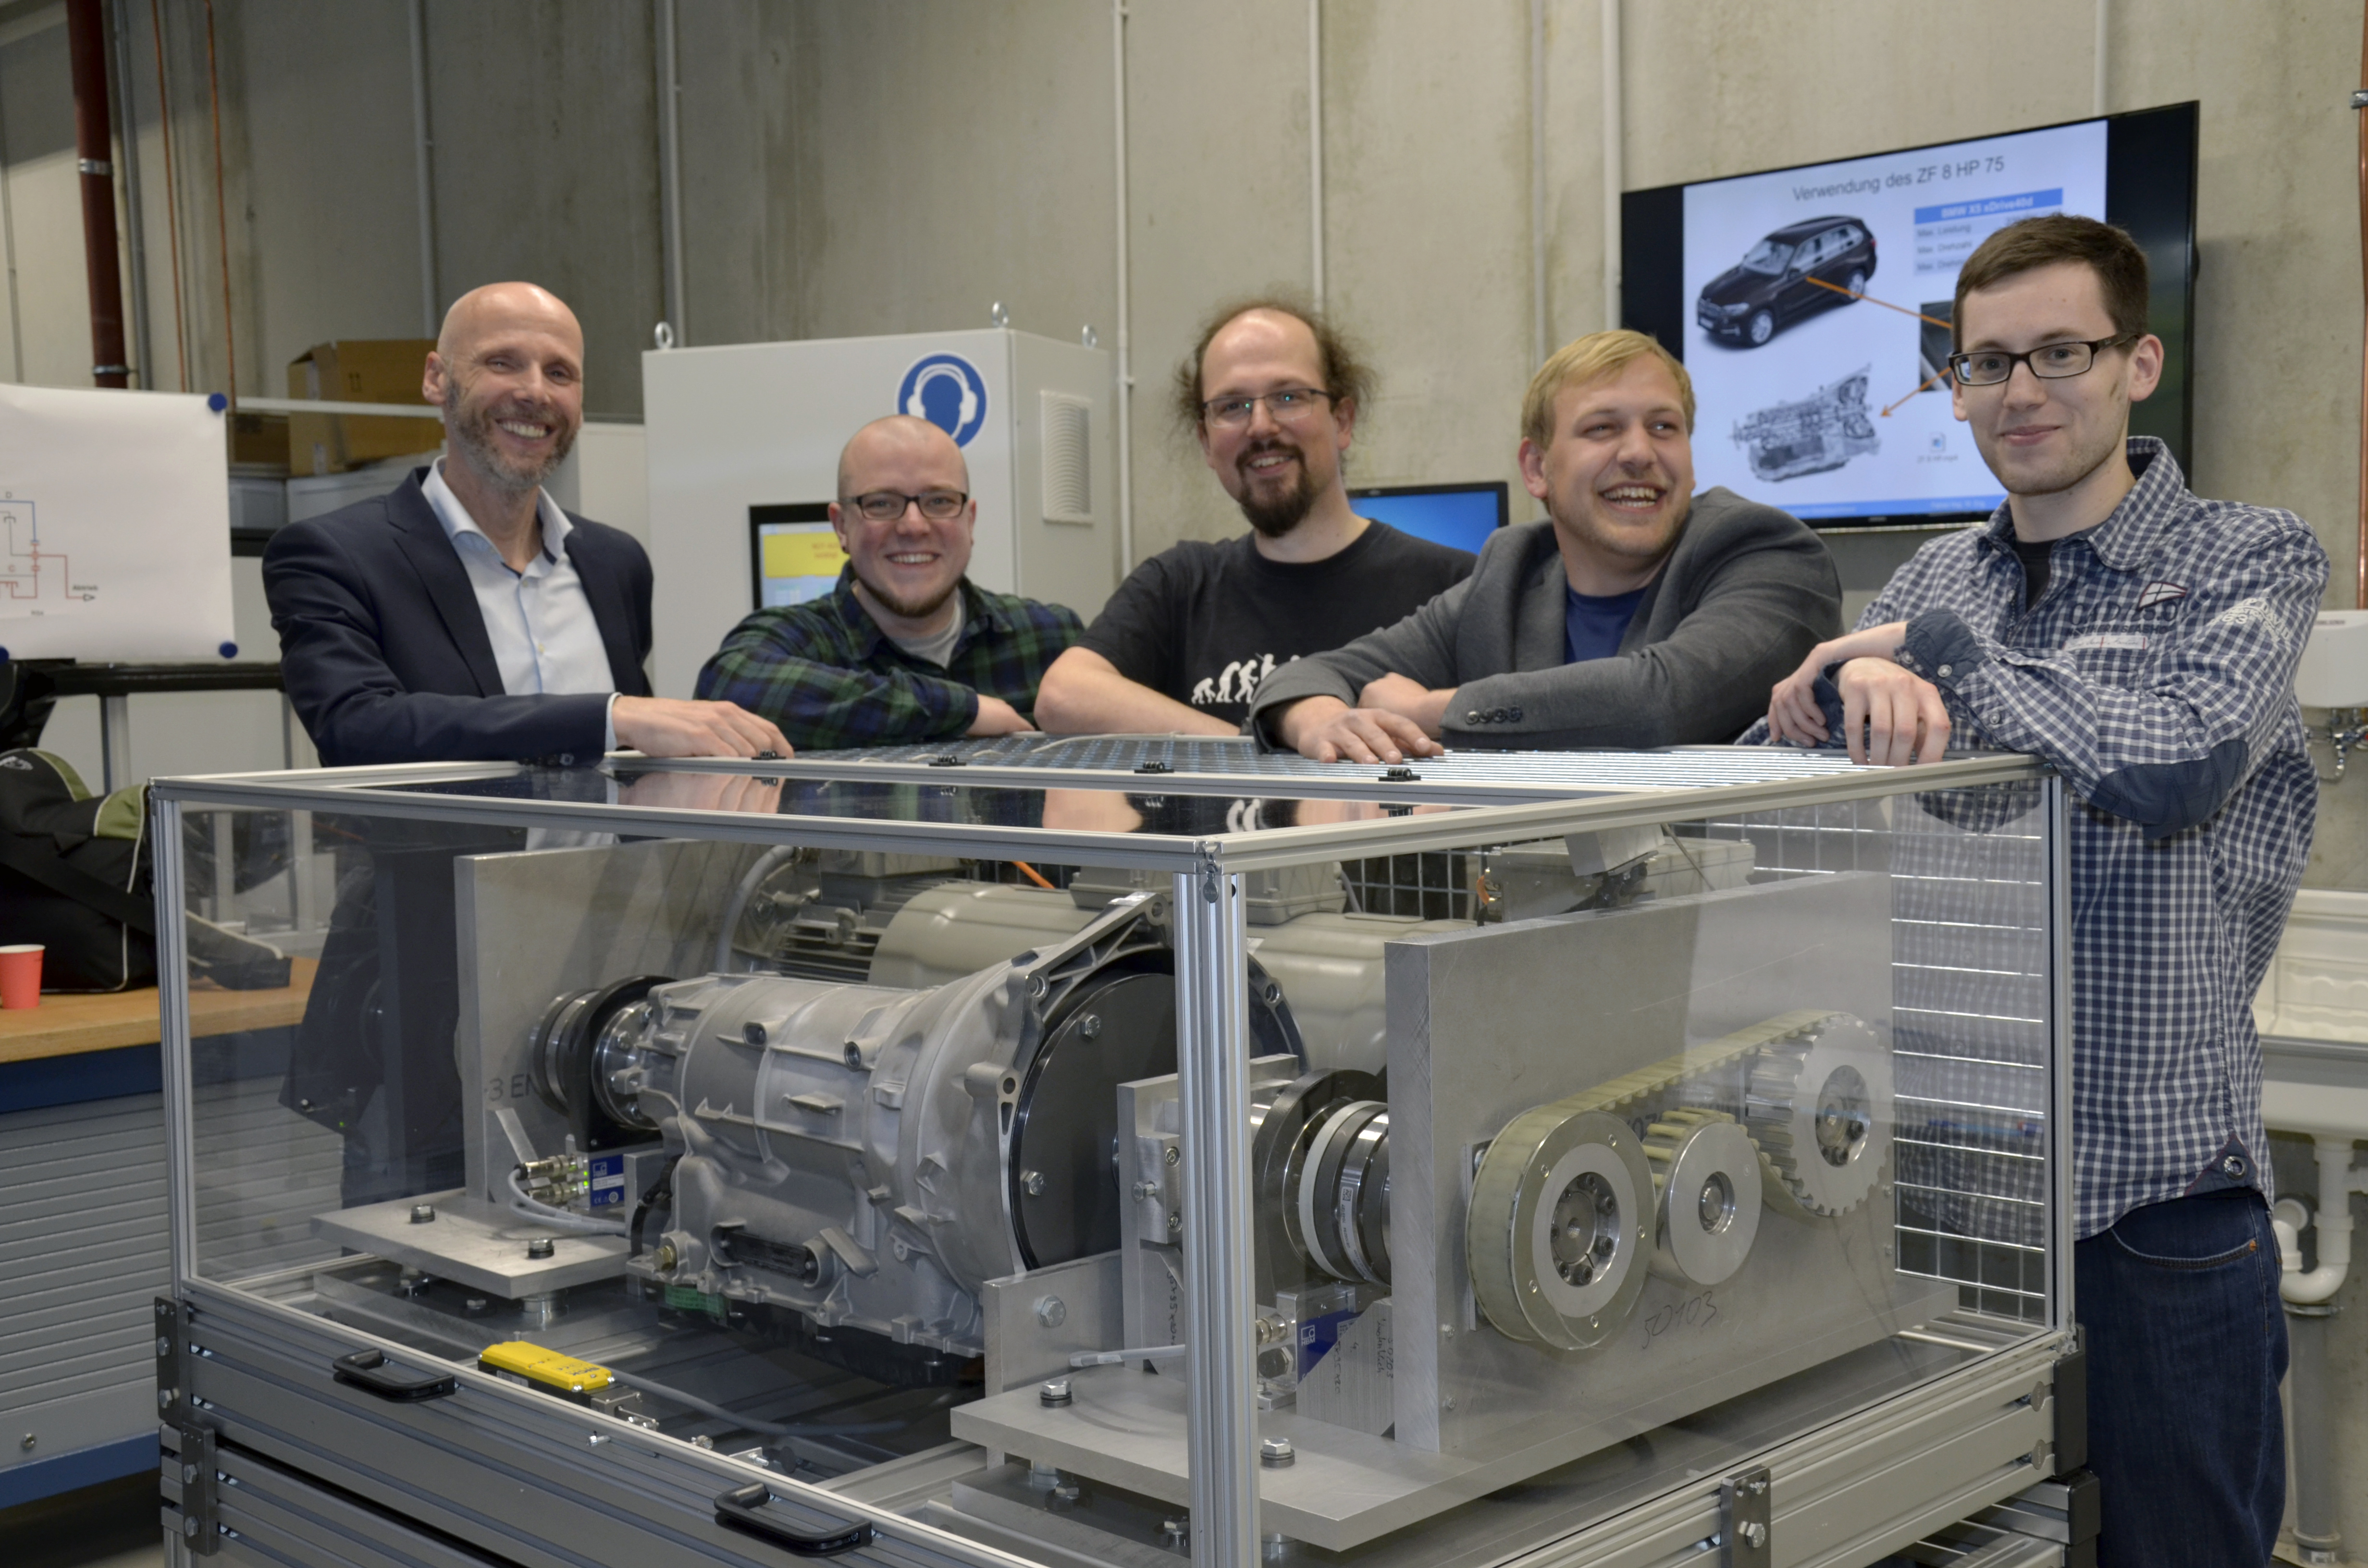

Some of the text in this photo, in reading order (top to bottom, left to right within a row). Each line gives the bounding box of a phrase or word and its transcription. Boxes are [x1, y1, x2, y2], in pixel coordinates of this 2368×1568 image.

[1792, 156, 2005, 201] Verwendung des ZF 8 HP 75
[1301, 1336, 1315, 1346] HBM
